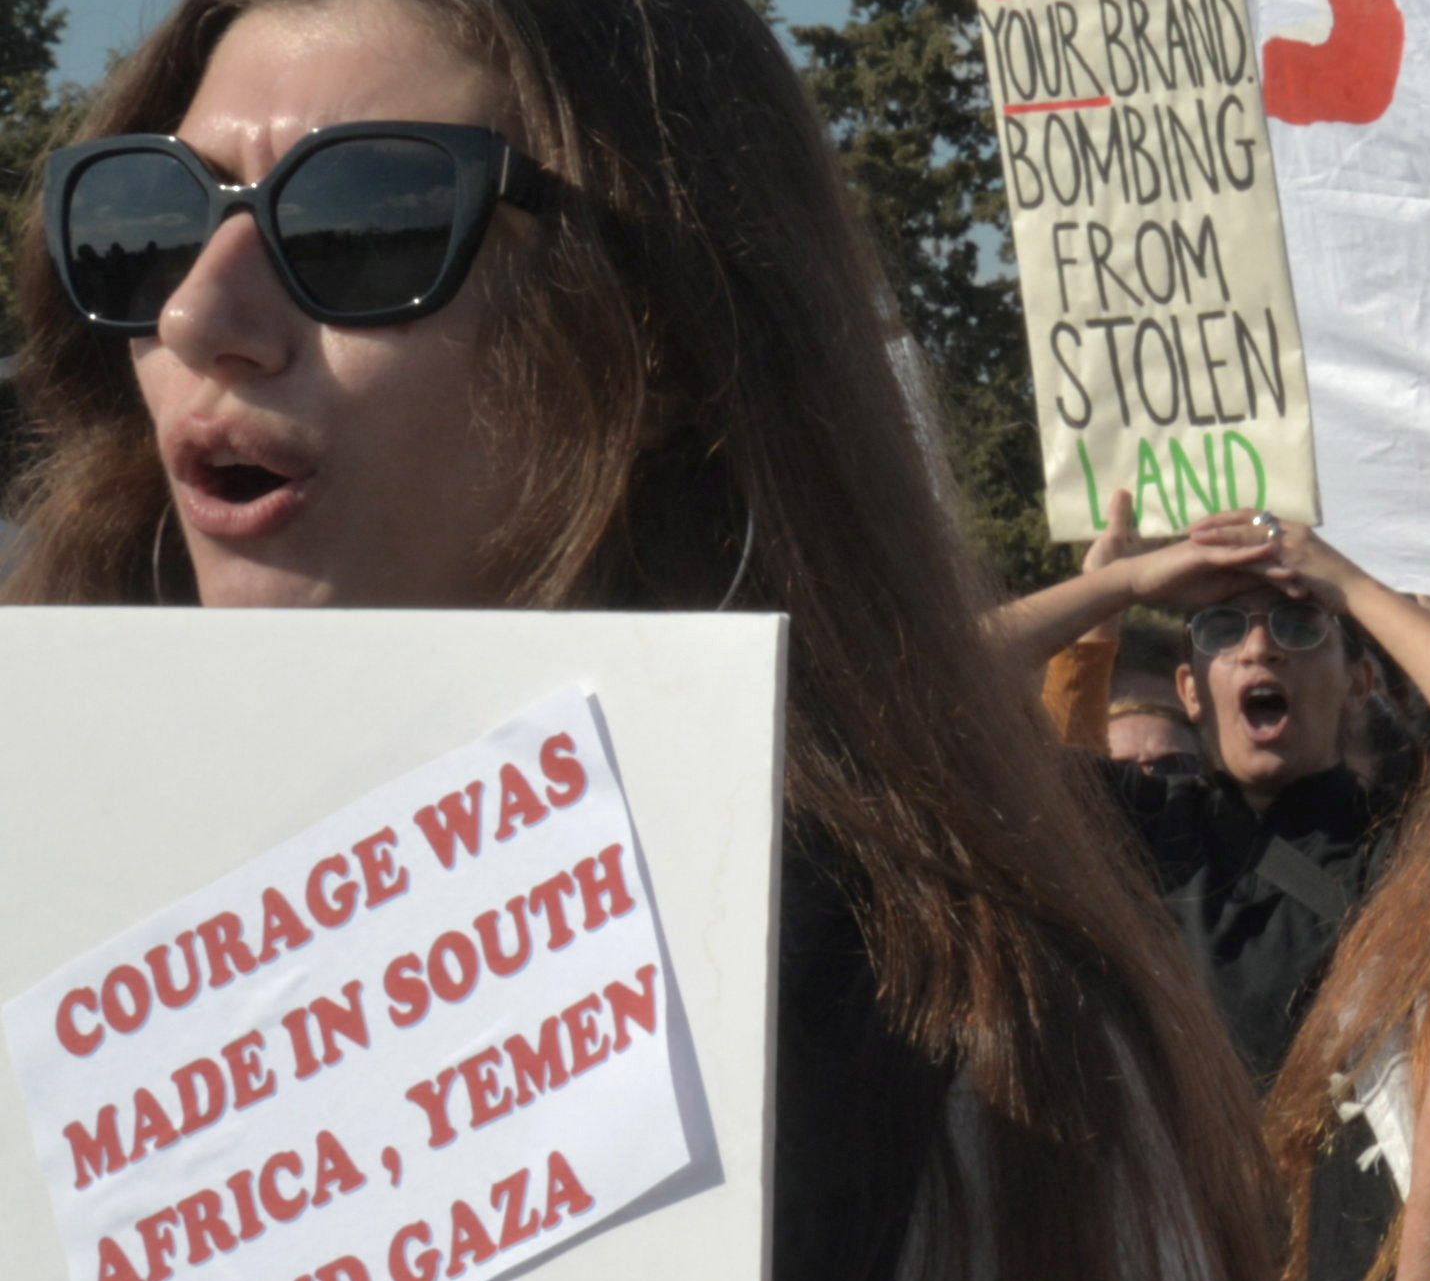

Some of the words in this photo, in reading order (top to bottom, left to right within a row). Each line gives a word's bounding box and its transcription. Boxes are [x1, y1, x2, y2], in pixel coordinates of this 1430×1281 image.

[980, 1, 1104, 105] YOUR
[1004, 93, 1257, 211] BOMBING
[1053, 214, 1230, 313] FROM
[1050, 308, 1286, 430] STOLEN
[1076, 430, 1268, 531] LAND
[55, 827, 409, 1057] COURAGE
[413, 732, 587, 869] WAS
[63, 1030, 277, 1189] MADE
[283, 980, 370, 1080] IN
[383, 843, 636, 1028] SOUTH
[406, 963, 658, 1149] YEMEN
